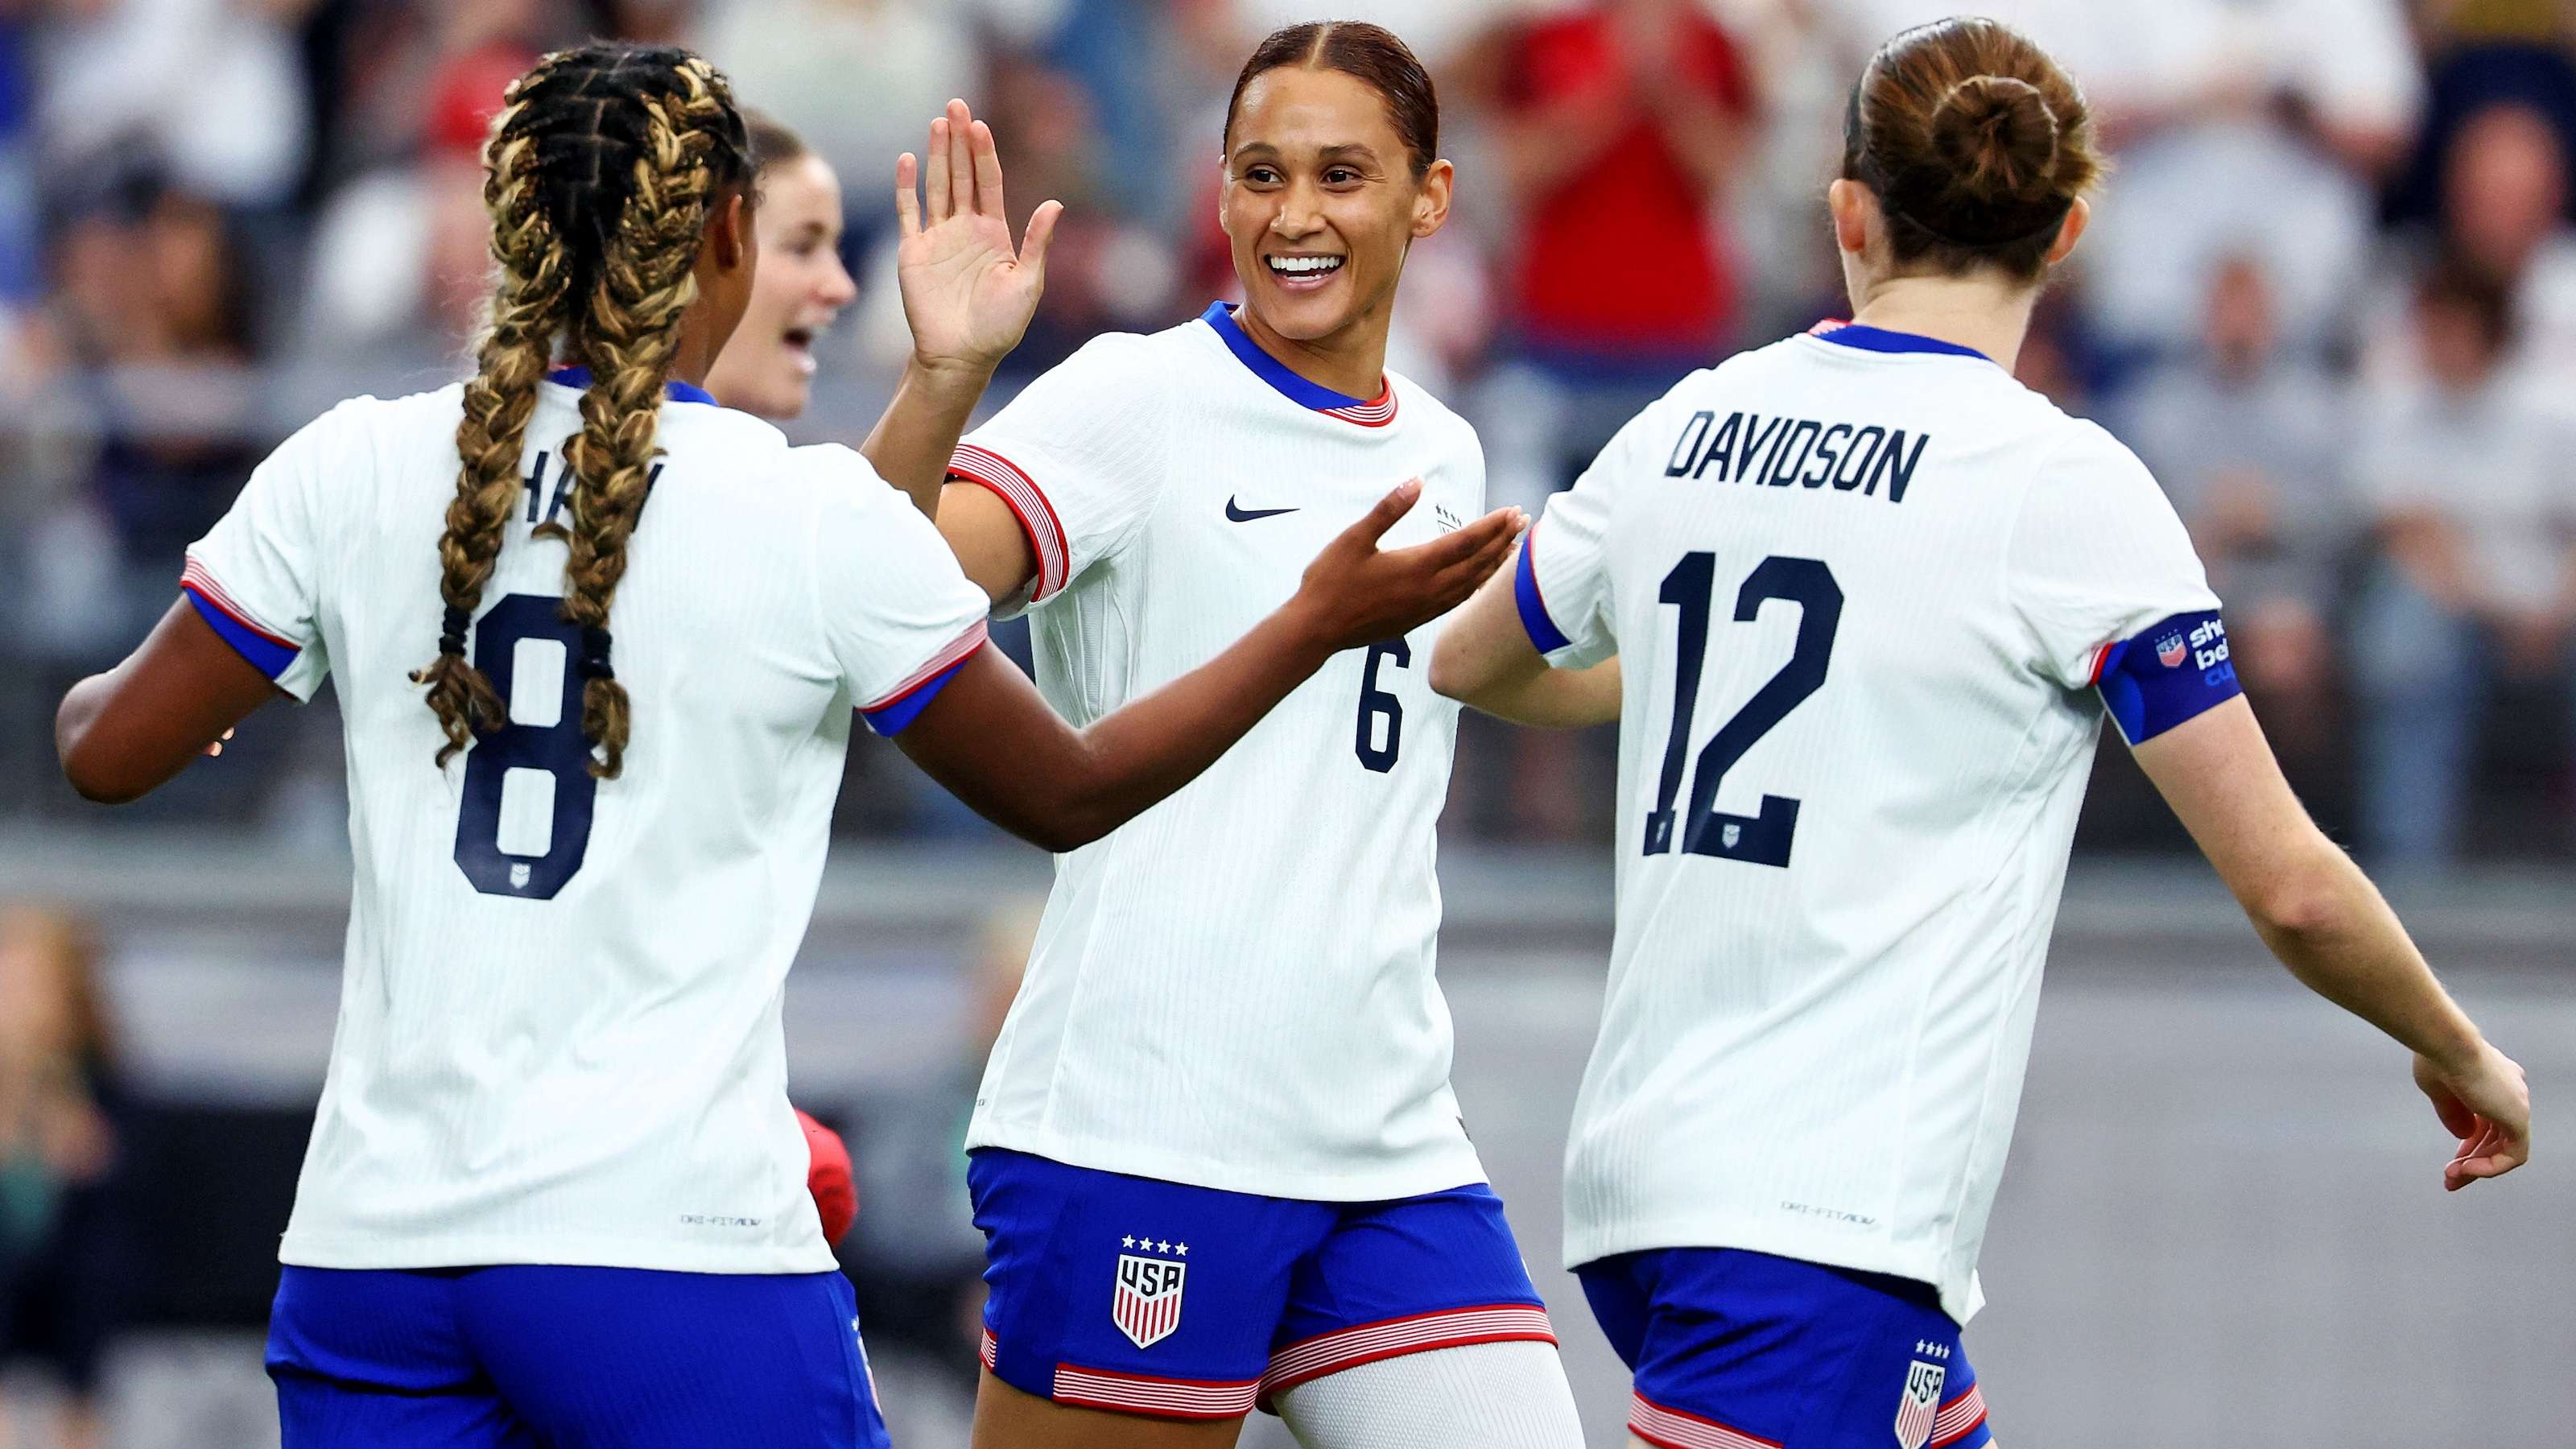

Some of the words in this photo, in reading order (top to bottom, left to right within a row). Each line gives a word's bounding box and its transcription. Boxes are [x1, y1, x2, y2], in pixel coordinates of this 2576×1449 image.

[1665, 411, 1930, 503] DAVIDSON
[454, 593, 602, 900] 8
[1355, 634, 1411, 774] 6
[1642, 551, 1844, 868] 12
[1121, 1260, 1181, 1297] USA
[1910, 1365, 1942, 1403] USA
